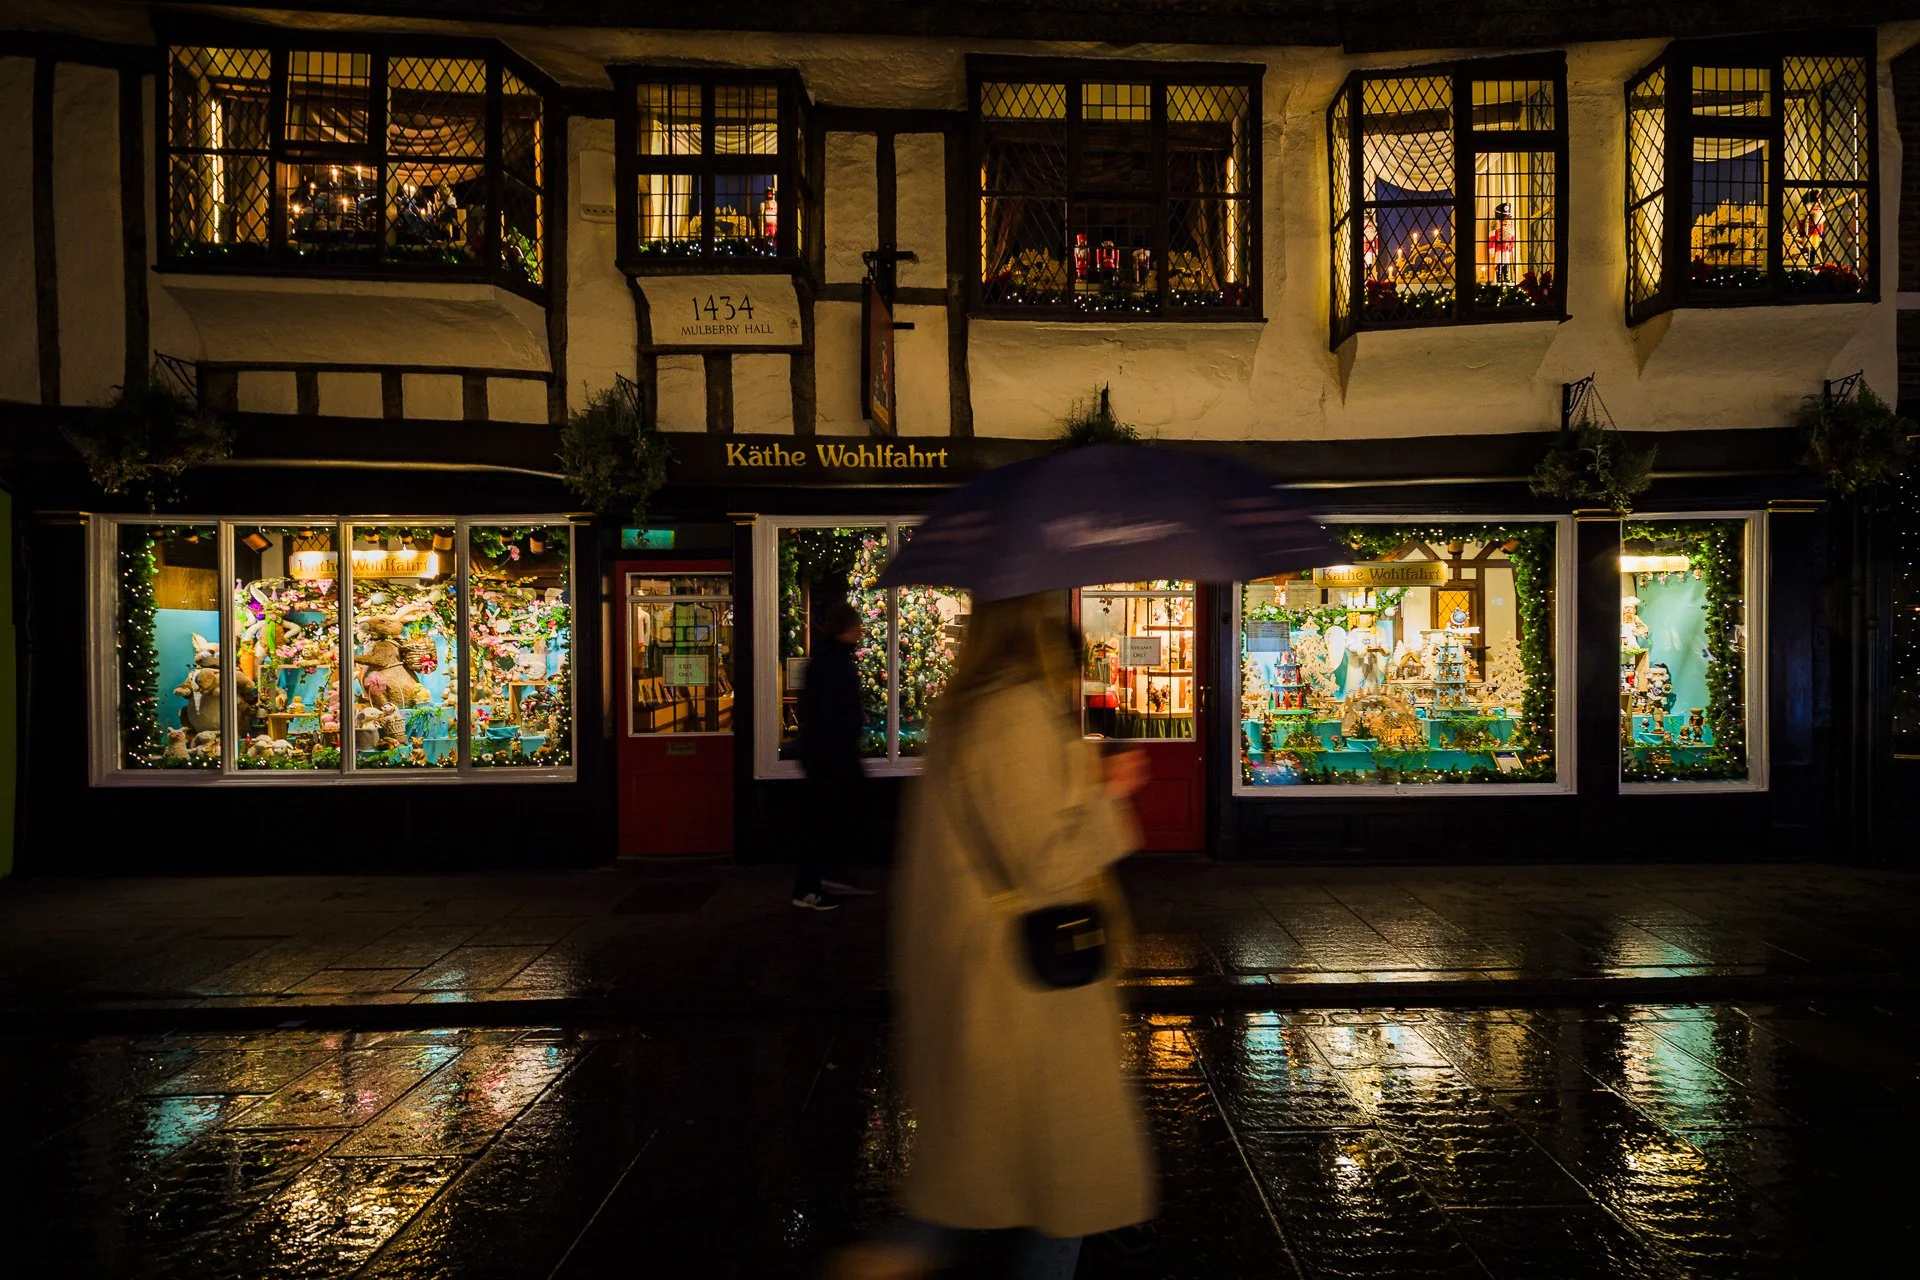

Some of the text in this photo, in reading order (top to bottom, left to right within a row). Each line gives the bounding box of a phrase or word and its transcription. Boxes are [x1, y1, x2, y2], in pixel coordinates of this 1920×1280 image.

[691, 293, 755, 322] 1434
[680, 323, 774, 336] MULBERRY HALL
[725, 443, 949, 468] Käthe Wohlfahrt
[1369, 567, 1442, 581] Wohlfahrt
